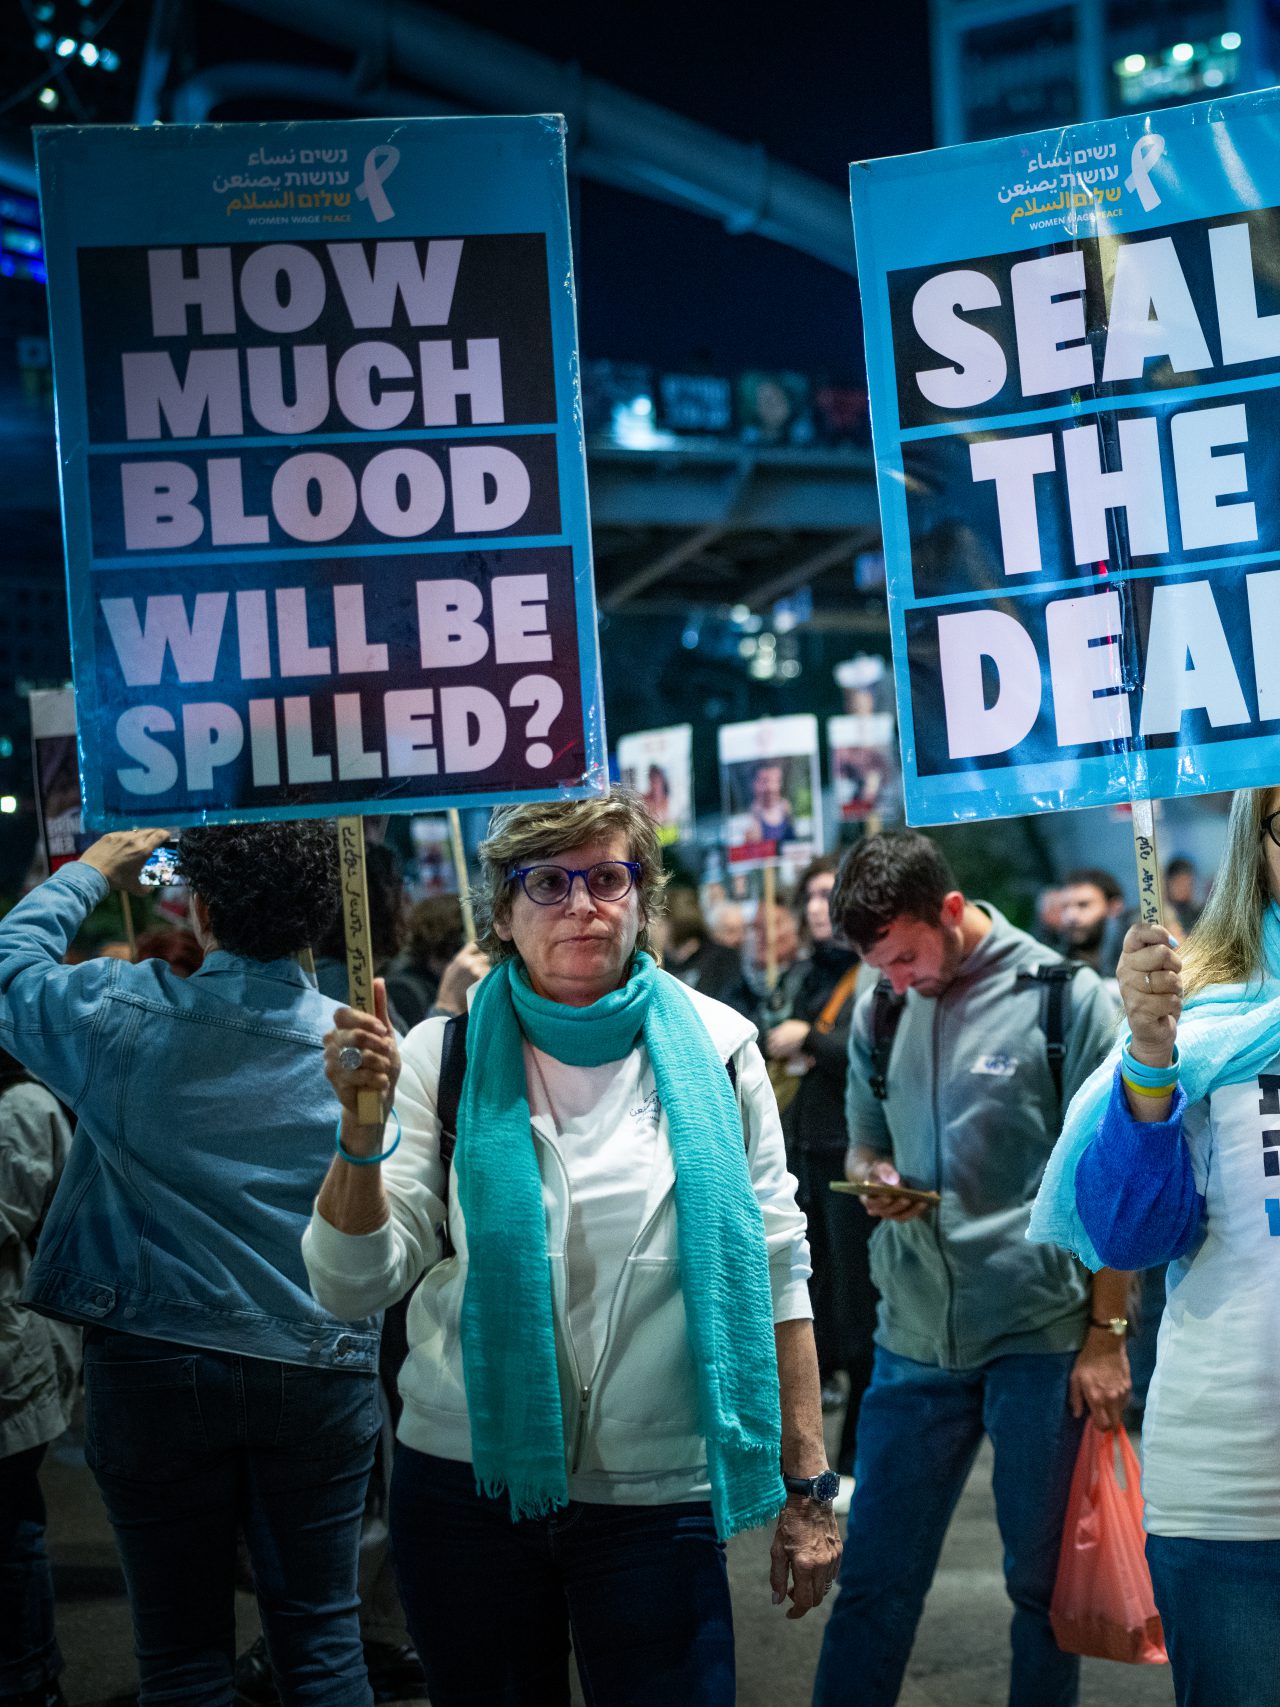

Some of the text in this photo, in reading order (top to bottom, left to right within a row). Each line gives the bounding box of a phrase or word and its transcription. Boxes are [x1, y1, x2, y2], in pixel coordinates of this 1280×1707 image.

[247, 147, 296, 166] نساء
[300, 149, 348, 165] נשים
[1074, 143, 1117, 165] נשים
[284, 170, 350, 186] עושות
[1060, 165, 1119, 188] עושות
[298, 189, 351, 208] שלום
[248, 214, 352, 225] WOMEN WAGE PEACE
[1029, 215, 1066, 231] WOMEN
[147, 239, 465, 337] HOW
[121, 337, 505, 441] MUCH
[120, 444, 531, 552] BLOOD
[969, 403, 1259, 576] THE
[100, 573, 554, 687] WILL BE
[116, 674, 565, 796] SPILLED?
